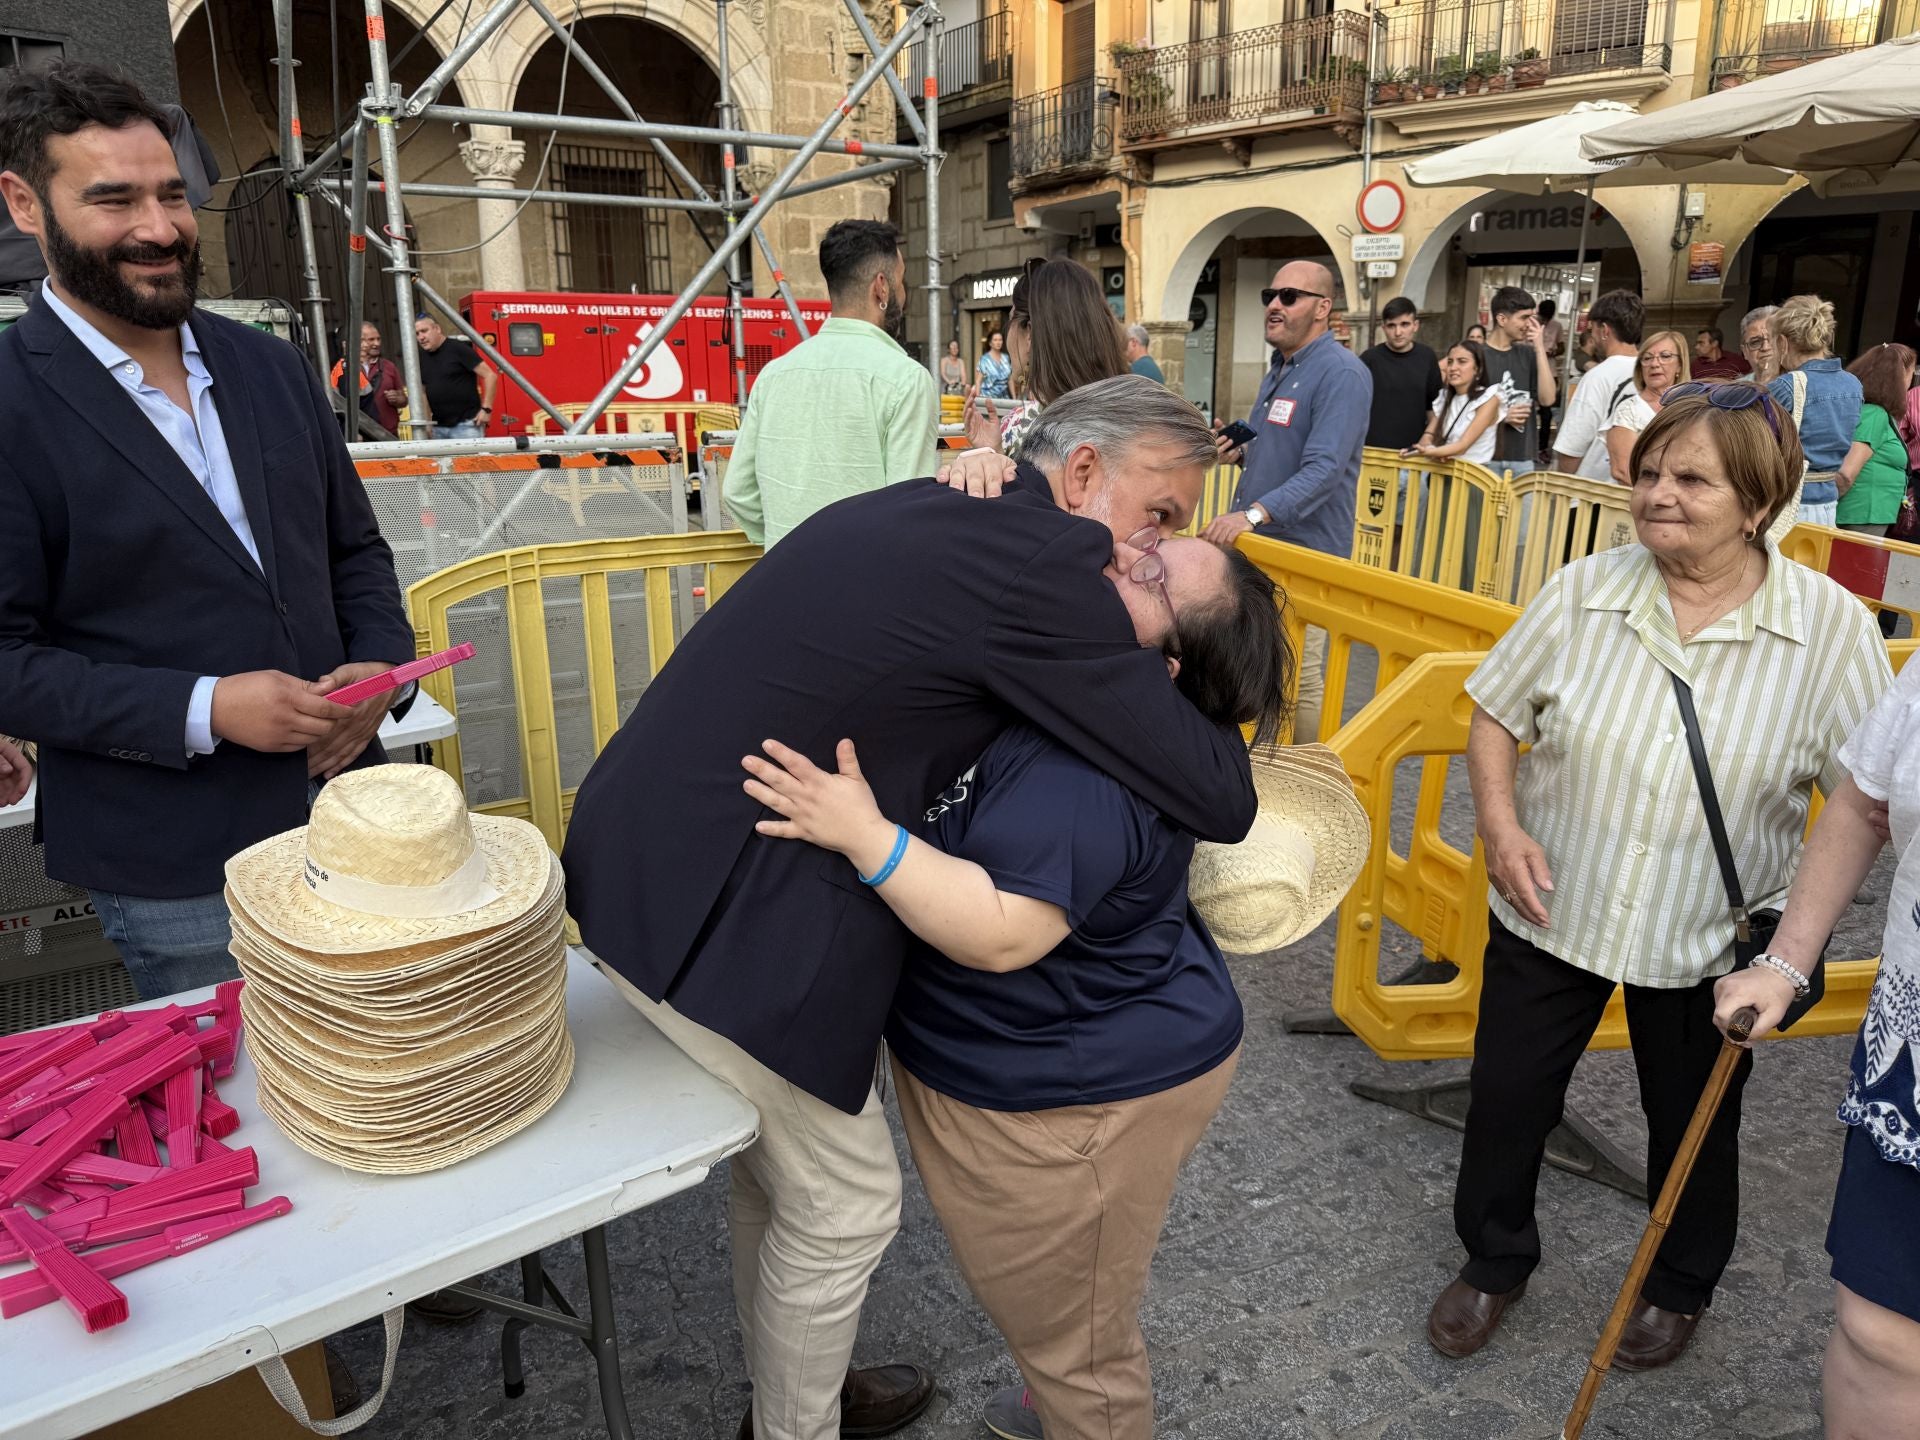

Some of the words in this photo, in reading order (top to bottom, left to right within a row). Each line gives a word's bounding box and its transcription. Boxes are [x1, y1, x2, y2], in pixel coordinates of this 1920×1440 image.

[502, 303, 568, 315] SERTRAGUA
[577, 305, 631, 316] ALQUILER
[633, 306, 648, 317] DE
[649, 306, 693, 318] GRS
[695, 307, 774, 319] ELECTGENOS
[321, 870, 329, 882] de
